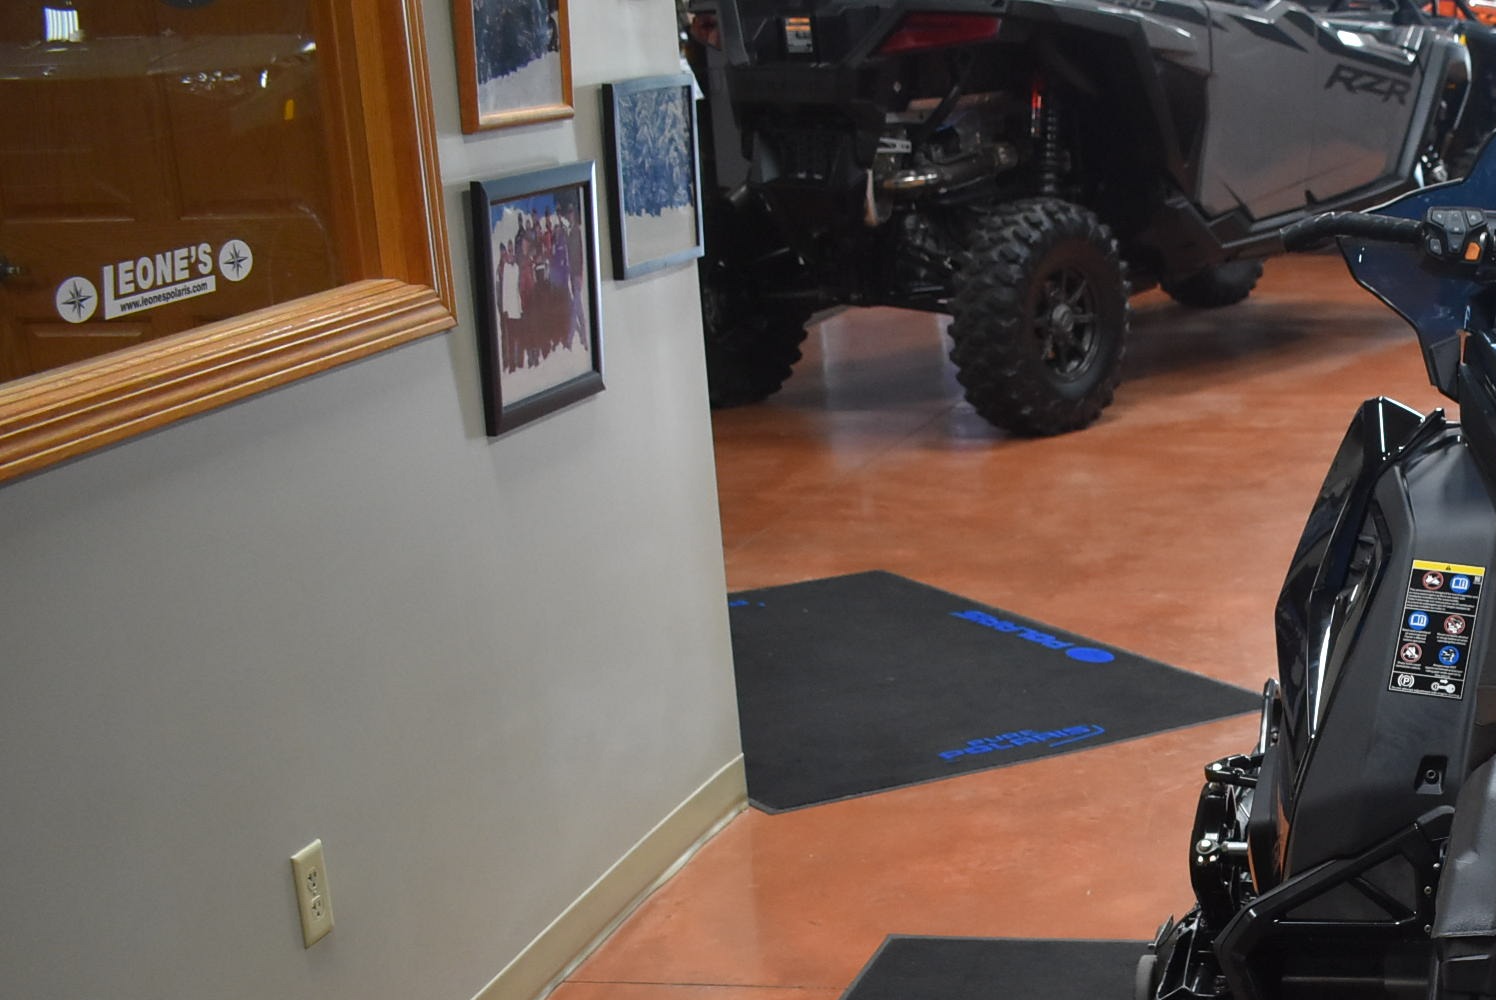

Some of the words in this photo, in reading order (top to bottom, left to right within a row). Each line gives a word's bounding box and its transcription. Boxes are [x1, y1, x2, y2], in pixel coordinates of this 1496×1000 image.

[1324, 63, 1412, 106] RZR
[103, 242, 213, 311] LEONE'S
[119, 282, 208, 312] www.leonespolaris.com
